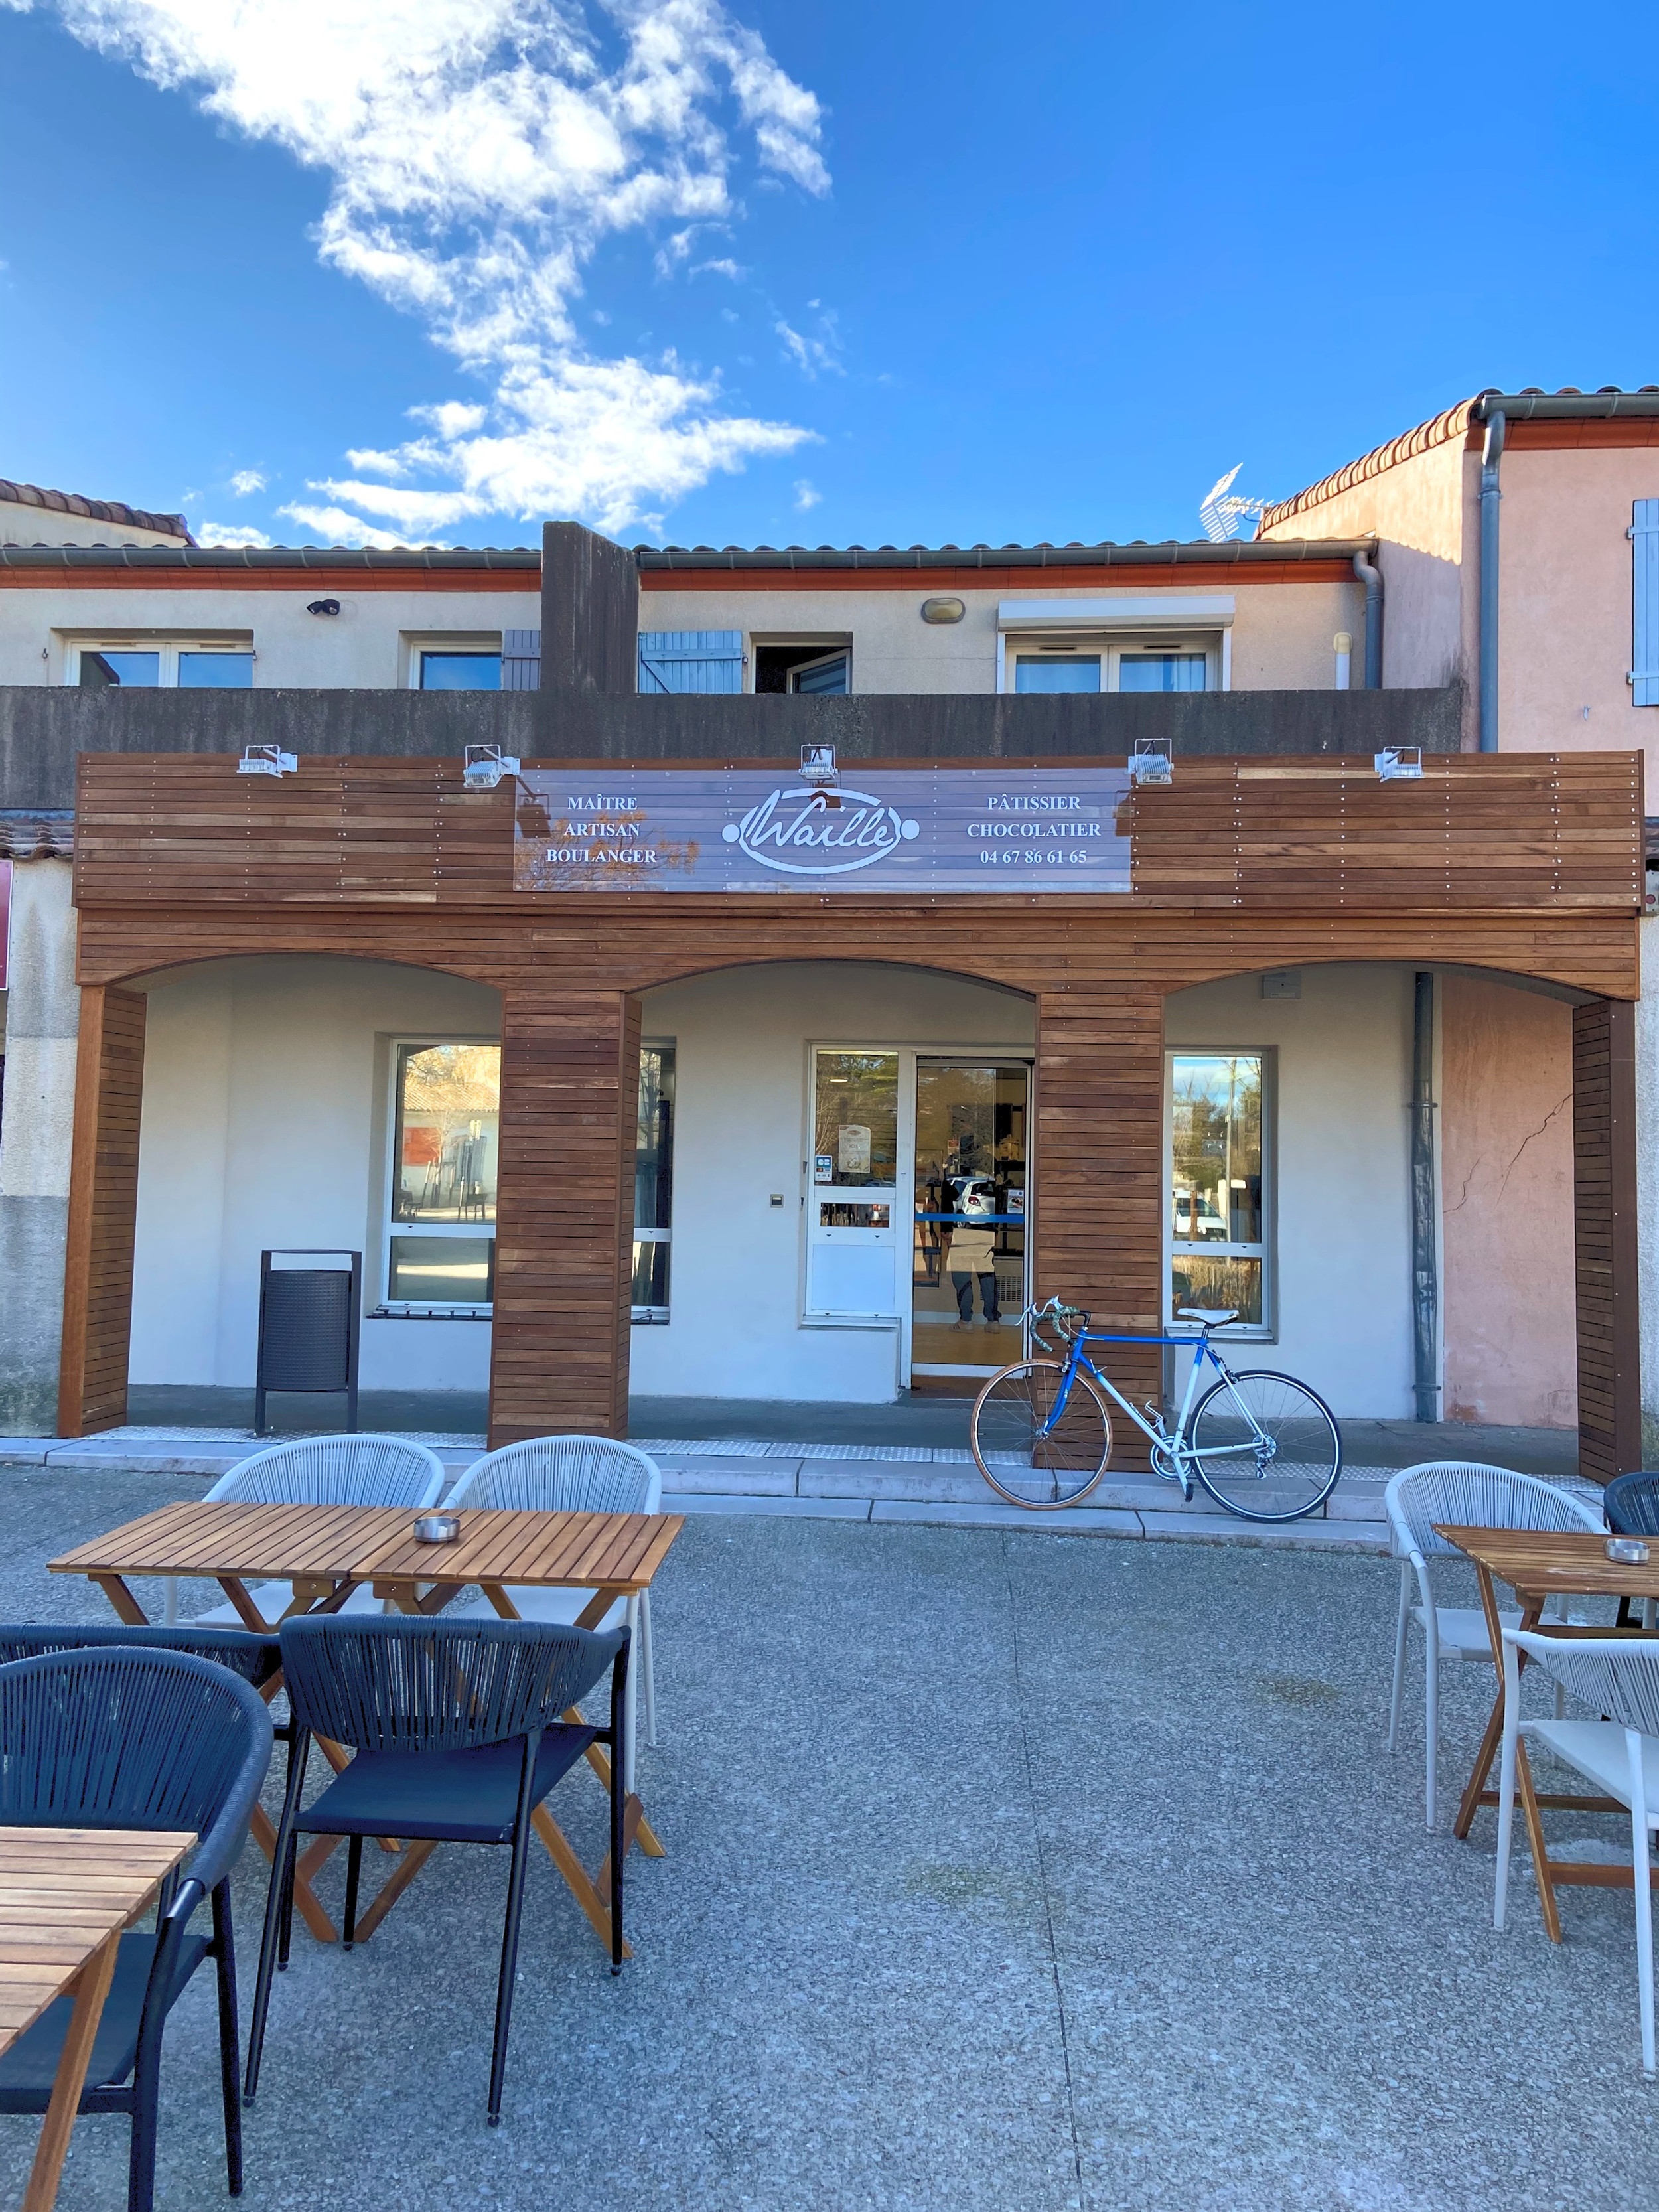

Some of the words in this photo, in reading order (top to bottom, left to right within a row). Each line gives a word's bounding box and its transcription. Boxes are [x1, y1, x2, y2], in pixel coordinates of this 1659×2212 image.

[567, 793, 638, 810] MAÎTRE
[987, 793, 1081, 810] PÂTISSIER
[743, 789, 894, 847] Waille
[563, 823, 640, 837] ARTISAN
[967, 823, 1102, 838] CHOCOLATIER
[546, 849, 656, 863] BOULANGER
[980, 850, 998, 863] 04
[1003, 850, 1021, 863] 67
[1025, 850, 1043, 863] 86
[1047, 850, 1063, 863] 61
[1070, 850, 1087, 863] 65
